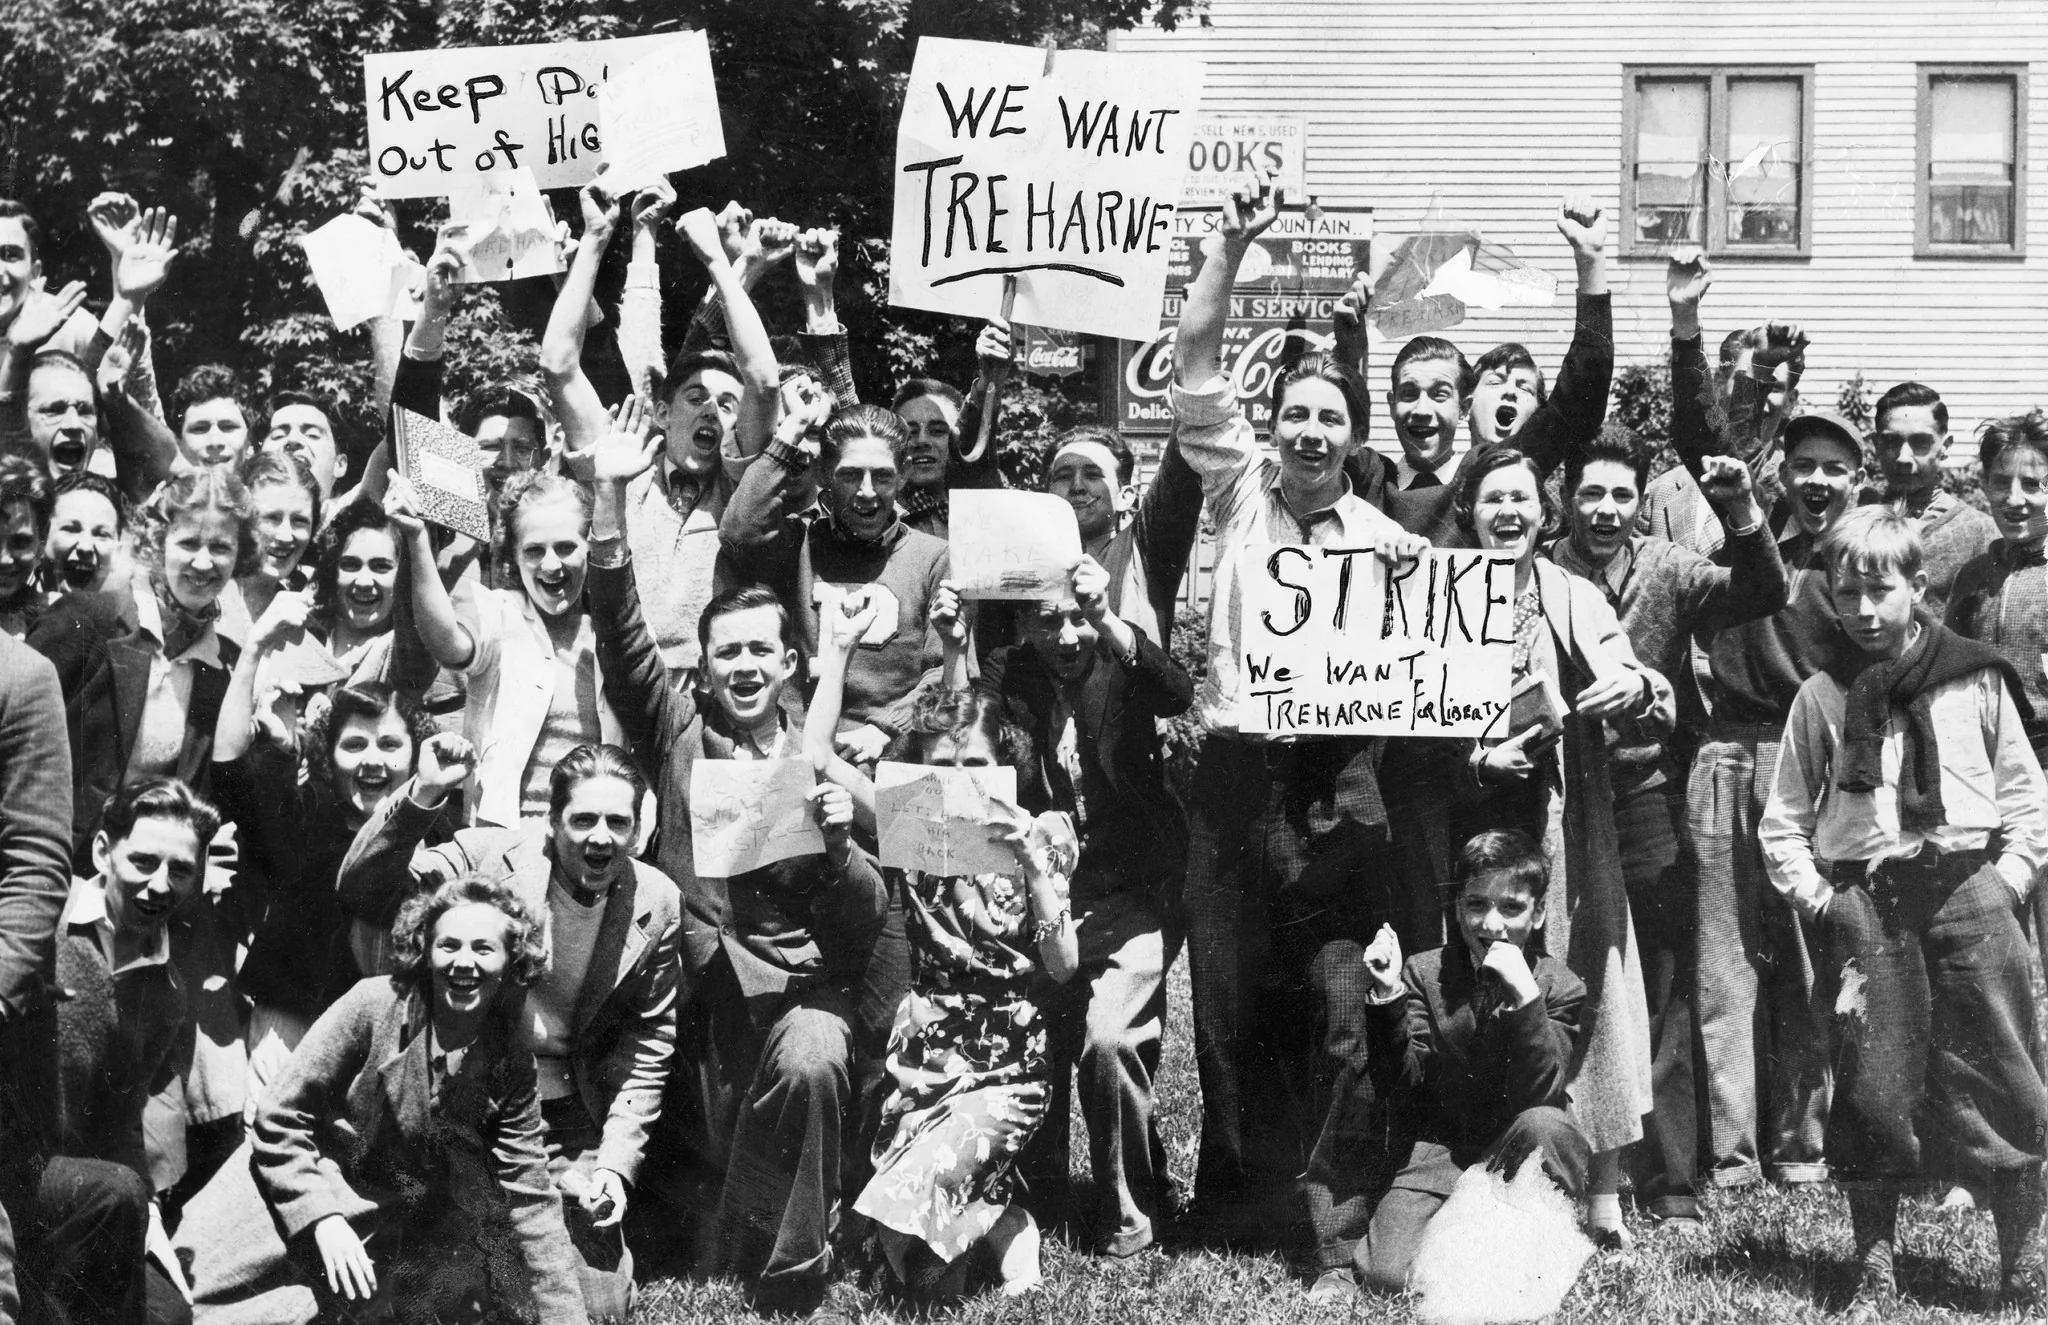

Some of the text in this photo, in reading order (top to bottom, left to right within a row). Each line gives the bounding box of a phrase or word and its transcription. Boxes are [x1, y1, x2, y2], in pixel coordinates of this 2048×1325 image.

[936, 81, 1180, 157] WE WANT
[1233, 124, 1255, 137] NEW
[1269, 125, 1298, 137] USED
[475, 130, 524, 171] of
[1188, 140, 1283, 173] OOKS
[902, 154, 1174, 268] TREHARNE
[1291, 240, 1353, 254] BOOKS
[1302, 255, 1354, 267] LENDING
[1261, 546, 1518, 649] STRIKE
[1326, 649, 1426, 685] WANT
[1250, 687, 1403, 730] TREHARNE
[917, 841, 956, 859] BACK
